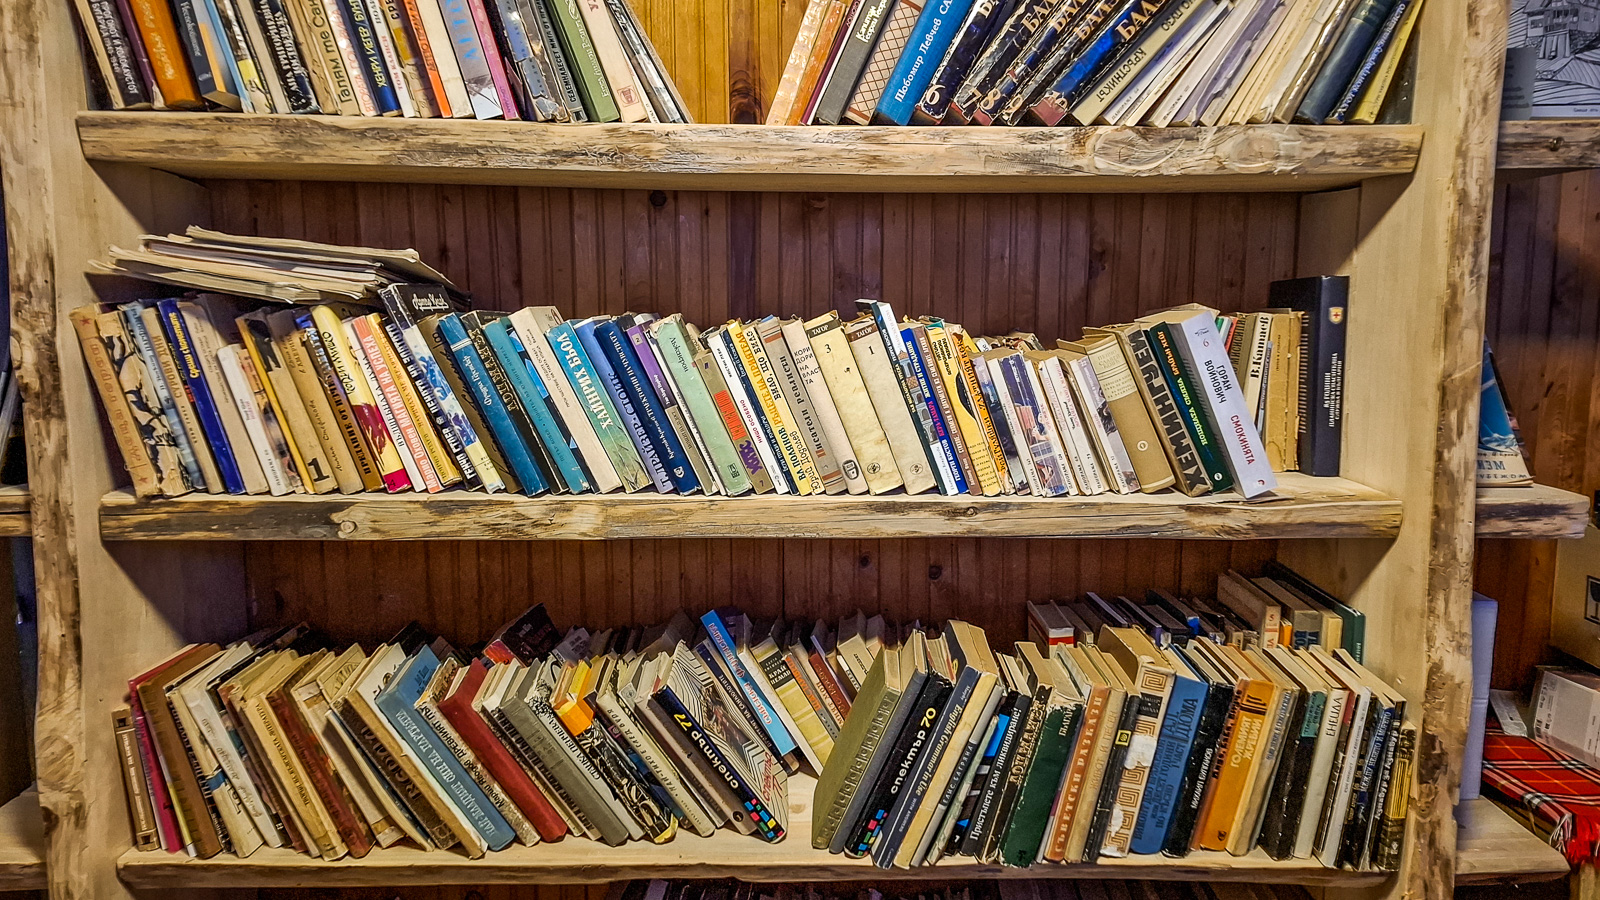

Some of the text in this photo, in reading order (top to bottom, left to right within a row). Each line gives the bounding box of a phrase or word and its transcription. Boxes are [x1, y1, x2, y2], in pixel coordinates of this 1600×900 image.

[320, 29, 352, 104] Галям те
[893, 18, 944, 102] Любомир Левчев
[1094, 48, 1149, 102] КРЪСТНИКЪТ
[927, 84, 946, 105] 6
[981, 91, 1001, 110] 8
[152, 334, 168, 357] ДНИ
[812, 324, 829, 335] ТАГОР
[856, 326, 872, 337] ТАГОР
[735, 332, 761, 378] ПРИЯТЕЛЯ
[756, 356, 770, 373] ЩО
[794, 346, 810, 357] КОРИ
[796, 354, 813, 364] ДОРИ
[824, 344, 831, 354] 3
[869, 346, 875, 355] 1
[905, 340, 922, 372] СТРАДАНИЕ
[1162, 347, 1181, 375] БРАЙЪН
[161, 359, 183, 398] СУРОВИ
[407, 363, 421, 377] НА
[467, 325, 520, 413] ЛОЦМАНЪТ
[555, 331, 614, 431] ХАЙНРИХ БЬОЛ
[1203, 358, 1228, 403] ВОЙНОВИЧ
[1216, 364, 1232, 391] ГОРАН
[415, 378, 440, 413] ЦЕНАТА
[918, 377, 931, 398] ЖИТИЕ
[1328, 352, 1337, 427] ПЛАНИНСКА СПАСИТЕЛНА
[338, 407, 349, 421] ОТ
[363, 334, 437, 488] Марио Оховен МАГИЯТА НА УСПЕХА
[738, 398, 763, 444] НИЩО ОСОБЕНО
[777, 354, 826, 458] Писатели реалисти
[1174, 377, 1209, 445] НОЩНАТА СМЯНА
[344, 422, 371, 475] ПРЕДАНИЕ
[441, 426, 461, 453] СТОЕВ
[941, 438, 954, 461] КОСТОВ
[1226, 413, 1259, 464] СМОКИНЯТА
[307, 460, 330, 482] 1
[455, 453, 475, 480] ГЕНЧО
[787, 429, 821, 492] Юрий Додолев
[949, 460, 961, 481] ГЕОРГИ
[767, 664, 788, 679] КРАЙ
[394, 708, 432, 753] ПАРТИЯТА
[418, 703, 435, 722] ПЪТ
[672, 710, 693, 732] 77
[941, 703, 964, 736] English
[1173, 695, 1201, 738] ДЮМА
[1324, 695, 1345, 737] ЕНЕИДА
[430, 717, 467, 760] ДРЕВНИЯТ
[888, 705, 938, 796] спектър 70
[924, 733, 949, 772] Grammar
[1229, 715, 1251, 768] ГОЛЕМИЯТ
[1366, 740, 1382, 768] НЕБЕТО
[1376, 710, 1391, 736] МОРЕТО
[426, 749, 443, 766] НА
[462, 757, 488, 786] Ягодов
[575, 751, 601, 781] СТАНКА
[686, 728, 742, 790] спектър
[952, 744, 975, 781] БАГРЯНА
[968, 706, 1024, 841] Пристъпете към ликвидиране!
[1053, 695, 1104, 853] СЪВЕТСКИ РАЗКАЗИ
[1159, 740, 1177, 776] ГОДИНИ
[1372, 729, 1399, 820] Азнавур за Азнавур
[913, 779, 927, 797] Use
[1189, 747, 1214, 809] МИХАИЛ БУЛГАКОВ
